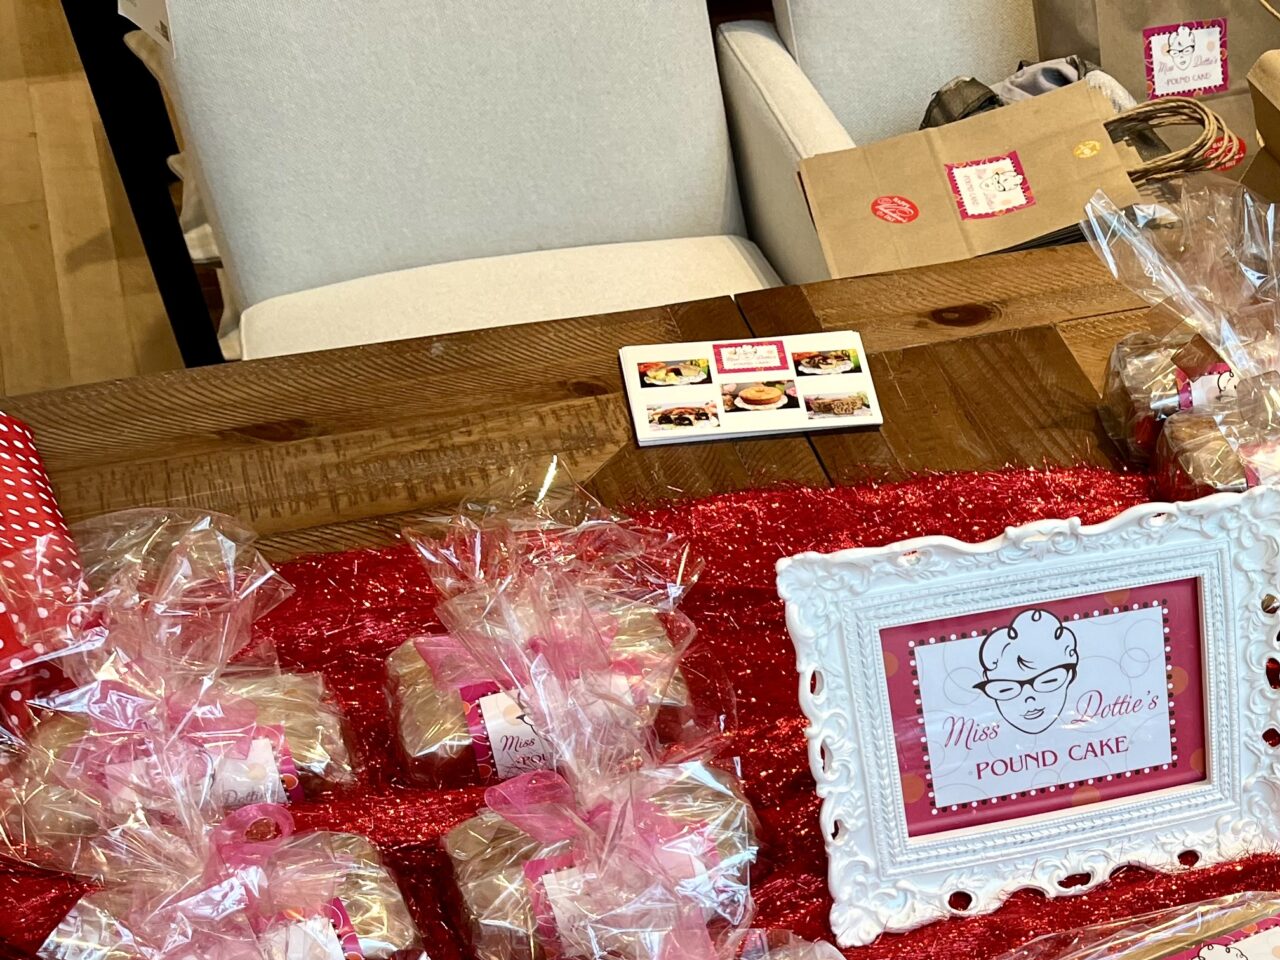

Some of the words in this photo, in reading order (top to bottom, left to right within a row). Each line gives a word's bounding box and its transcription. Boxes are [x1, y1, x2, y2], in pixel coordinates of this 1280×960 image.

[499, 734, 536, 752] Miss
[942, 715, 1001, 751] Miss
[1071, 689, 1160, 724] Dottie's
[976, 749, 1059, 781] POUND
[1068, 735, 1130, 762] CAKE
